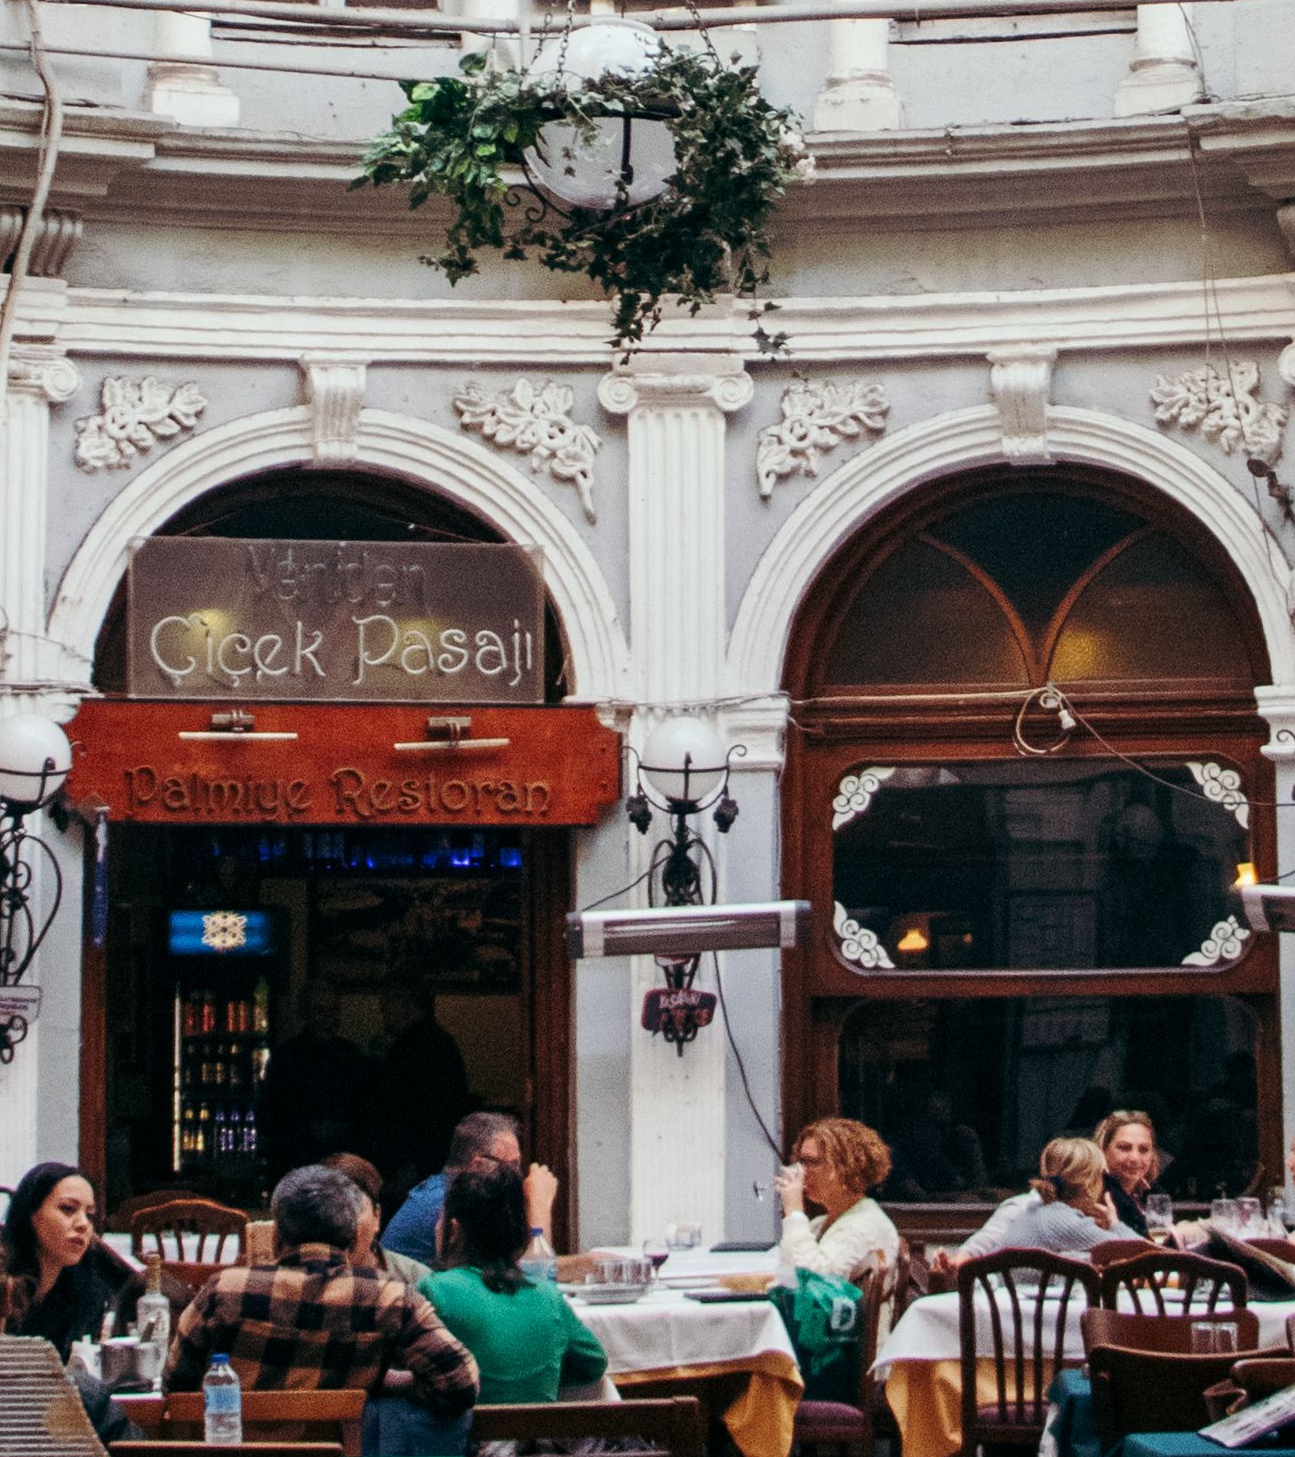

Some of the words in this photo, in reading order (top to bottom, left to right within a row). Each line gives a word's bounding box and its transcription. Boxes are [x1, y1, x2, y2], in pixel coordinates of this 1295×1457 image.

[150, 612, 327, 688] Çiçek
[122, 764, 313, 821] Palmiye
[329, 766, 552, 821] Restoran
